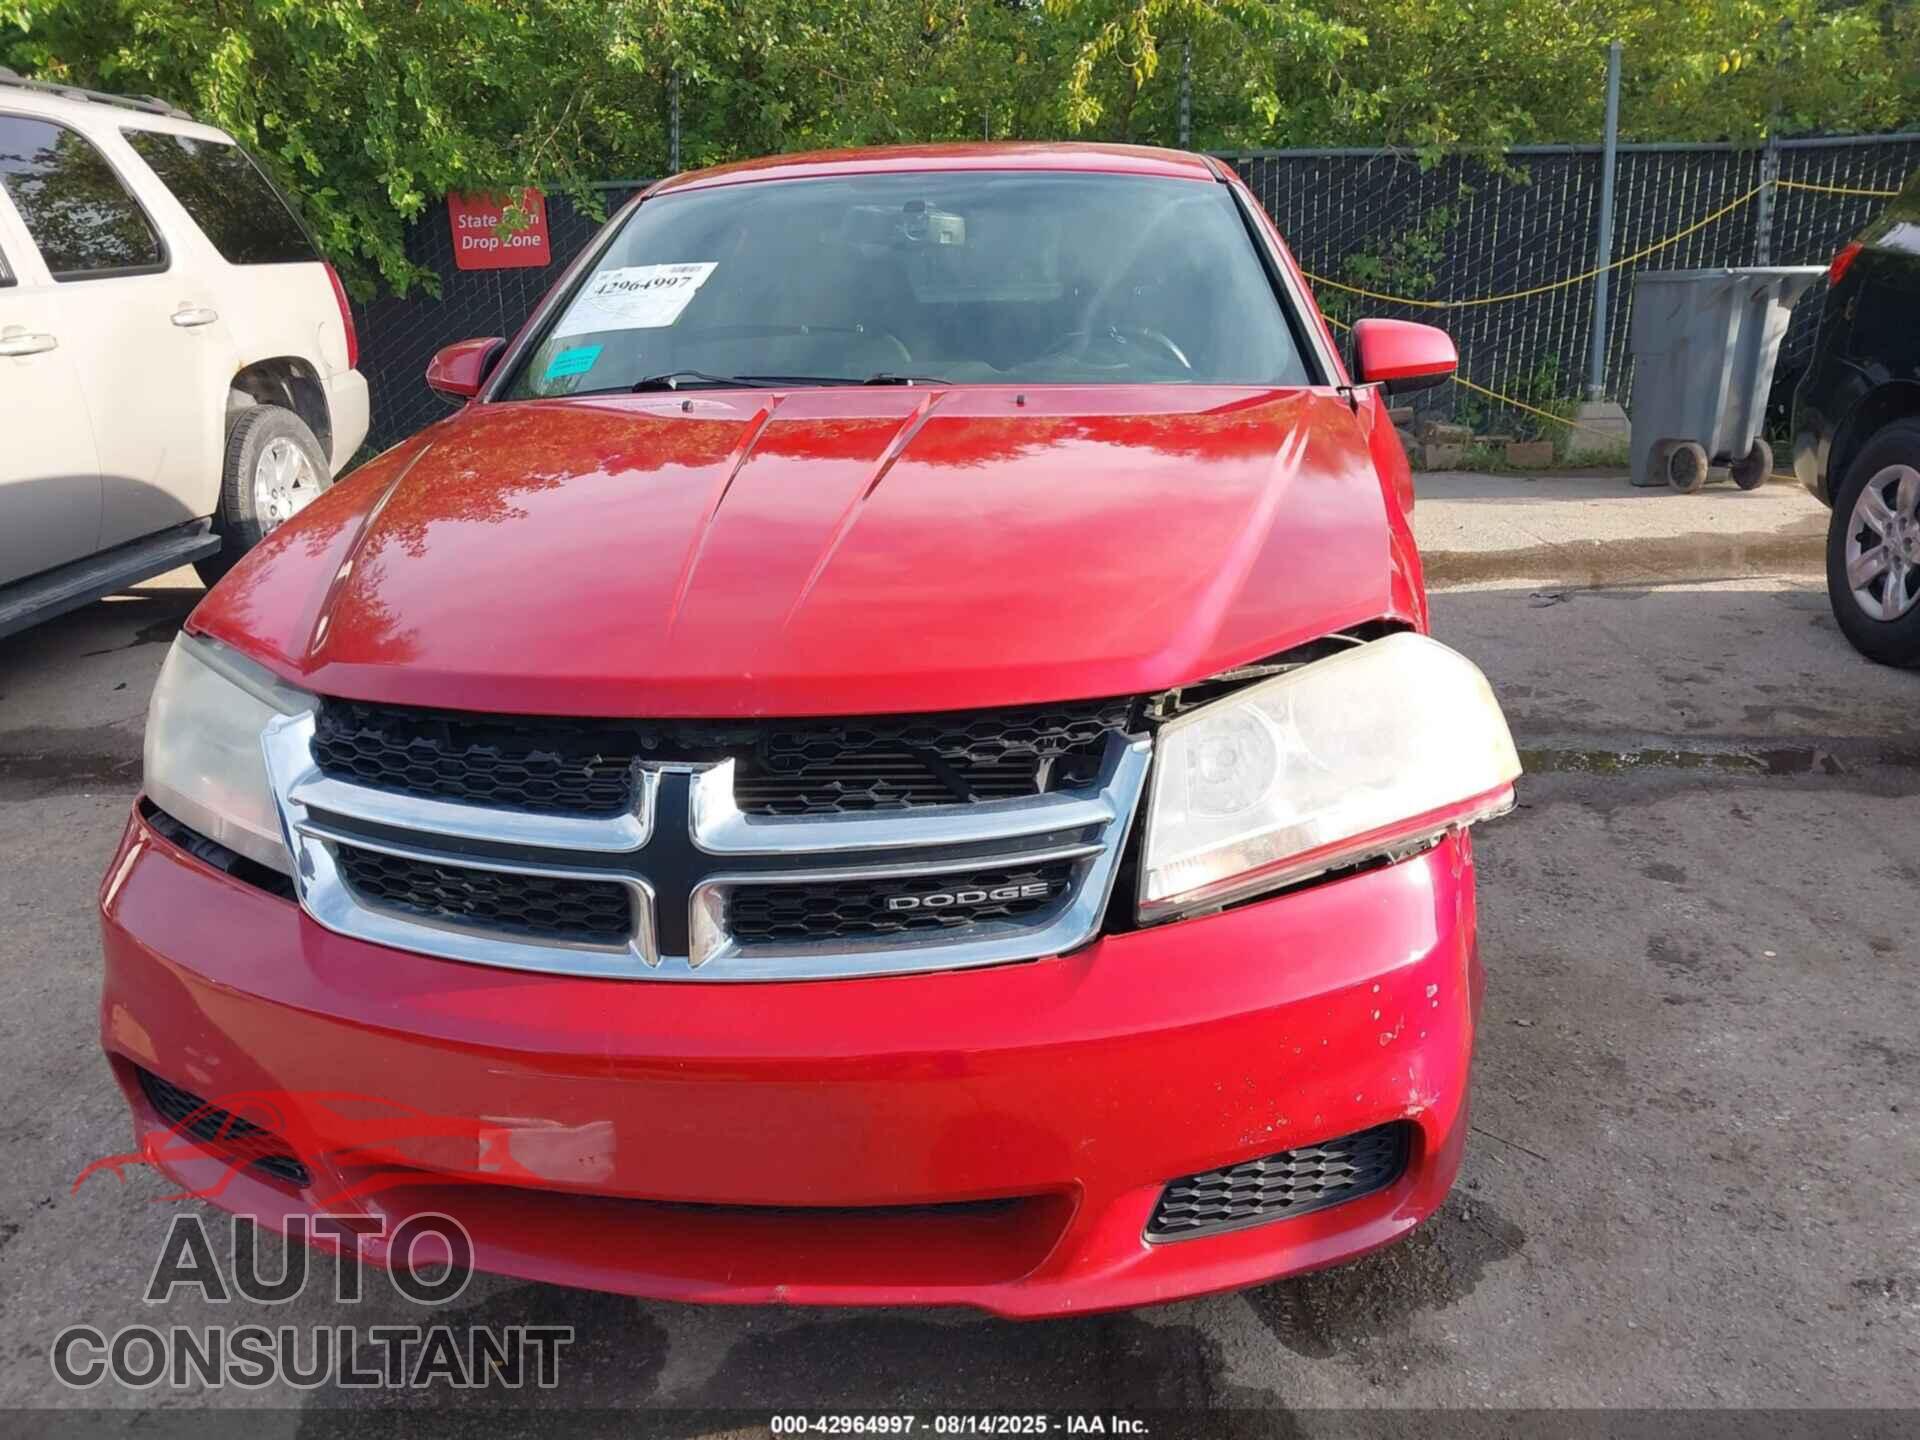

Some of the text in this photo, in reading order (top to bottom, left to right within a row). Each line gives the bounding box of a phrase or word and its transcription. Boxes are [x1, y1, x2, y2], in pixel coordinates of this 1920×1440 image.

[458, 214, 497, 229] State
[462, 234, 541, 252] Drop Zone
[889, 882, 1049, 910] DODGE
